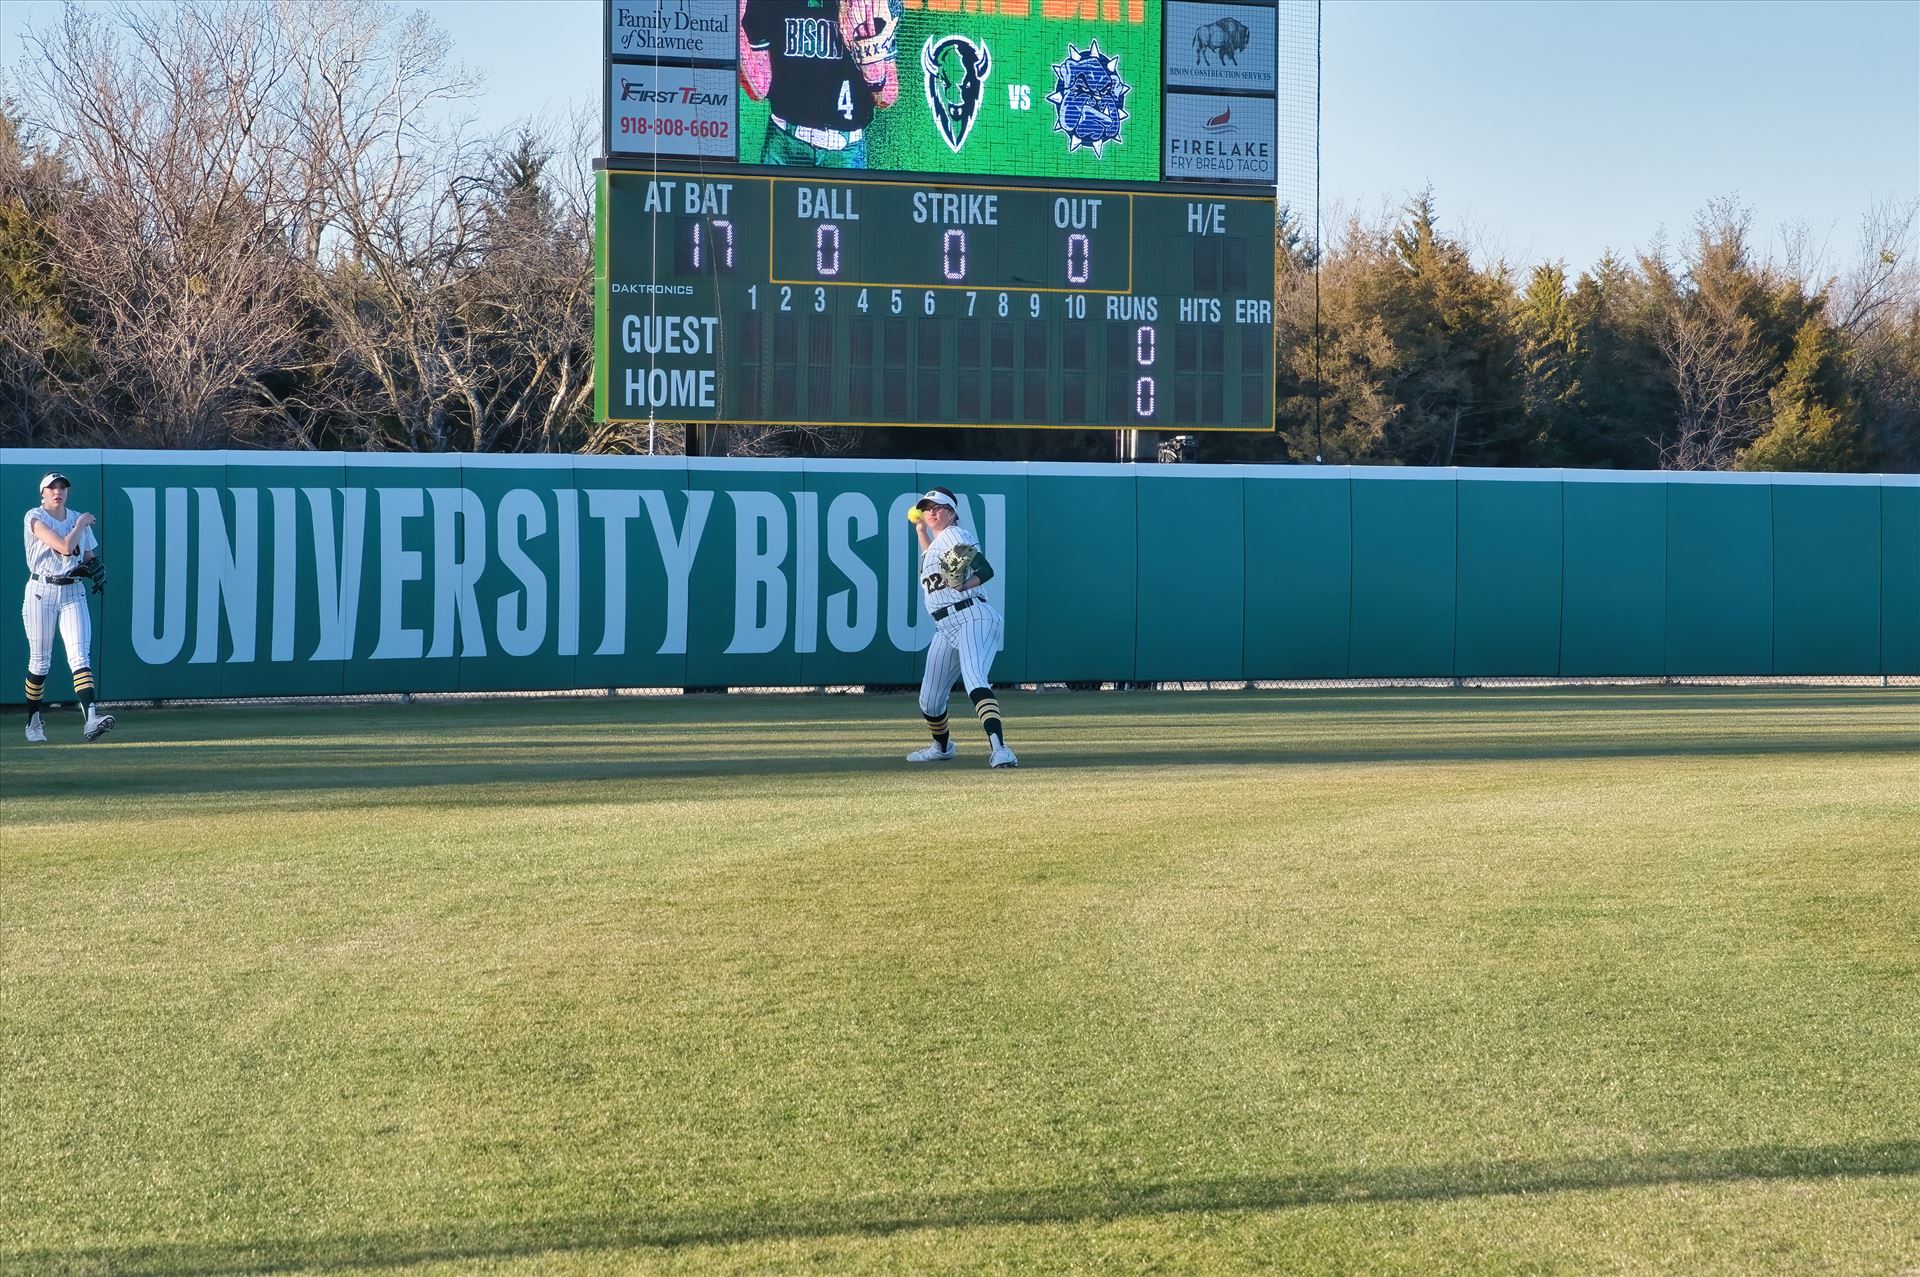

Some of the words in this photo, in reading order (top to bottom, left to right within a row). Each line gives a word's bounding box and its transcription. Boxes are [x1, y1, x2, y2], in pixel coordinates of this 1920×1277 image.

[617, 8, 672, 33] Family
[674, 11, 728, 32] Dental
[621, 29, 636, 49] of
[637, 29, 703, 50] Shawnee
[1169, 67, 1188, 76] BISON
[1190, 68, 1239, 78] CONSTRUCTION
[1242, 70, 1271, 81] SERVICES
[837, 80, 853, 120] 4
[1008, 84, 1030, 111] VS
[620, 117, 728, 138] 918-808-6602
[1171, 139, 1268, 157] FIRELAKE
[1171, 156, 1193, 169] FRY
[1196, 157, 1233, 171] BREAD
[1236, 159, 1268, 172] TACO
[644, 181, 676, 213] AT
[685, 183, 733, 215] BAT
[798, 187, 859, 220] BALL
[913, 191, 998, 225] STRIKE
[1054, 197, 1102, 229] OUT
[1187, 203, 1226, 235] H/E
[693, 220, 733, 268] 17
[817, 224, 839, 275] 0
[943, 229, 966, 280] 0
[1067, 233, 1089, 283] 0
[611, 283, 694, 295] DAKTRONICS
[748, 284, 757, 310] 1
[780, 286, 792, 312] 2
[814, 287, 826, 312] 3
[857, 288, 869, 313] 4
[891, 289, 902, 314] 5
[924, 290, 936, 316] 6
[966, 291, 977, 317] 7
[998, 292, 1009, 318] 8
[1029, 293, 1040, 318] 9
[1065, 294, 1086, 320] 10
[1106, 296, 1158, 321] RUNS
[1179, 298, 1221, 323] HITS
[1236, 299, 1271, 324] ERR
[622, 314, 719, 354] GUEST
[1137, 326, 1155, 365] 0
[625, 368, 716, 408] HOME
[1136, 376, 1155, 416] 0
[122, 485, 714, 666] UNIVERSITY
[922, 572, 947, 595] 22
